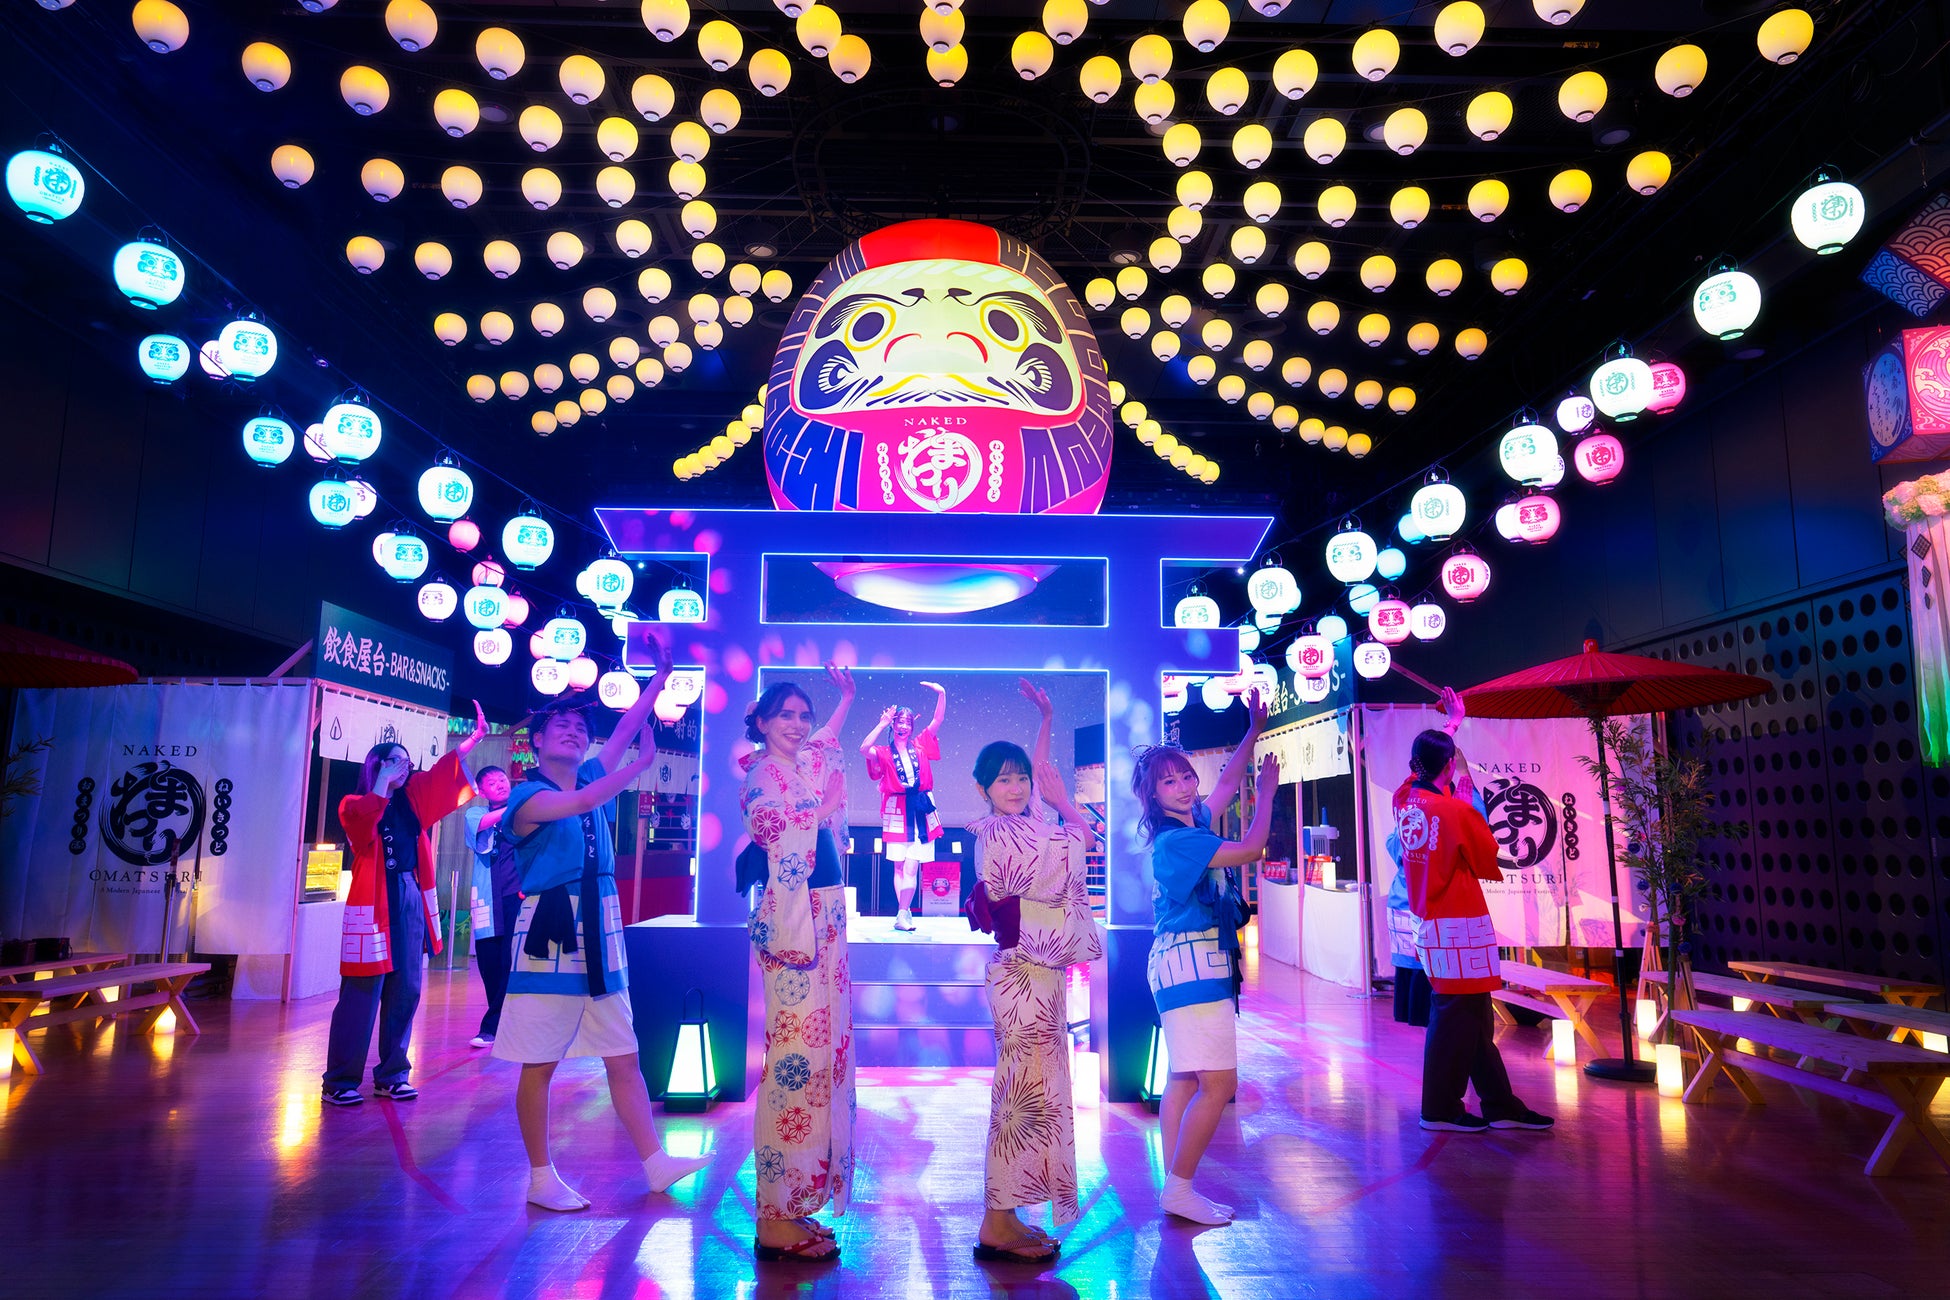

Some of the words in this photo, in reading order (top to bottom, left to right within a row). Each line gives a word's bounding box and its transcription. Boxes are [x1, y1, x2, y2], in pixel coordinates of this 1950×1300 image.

[904, 417, 967, 427] NAKED
[322, 626, 386, 677] 飲食屋台
[123, 744, 198, 757] NAKED
[1478, 762, 1542, 773] NAKED
[132, 887, 161, 895] Japanese
